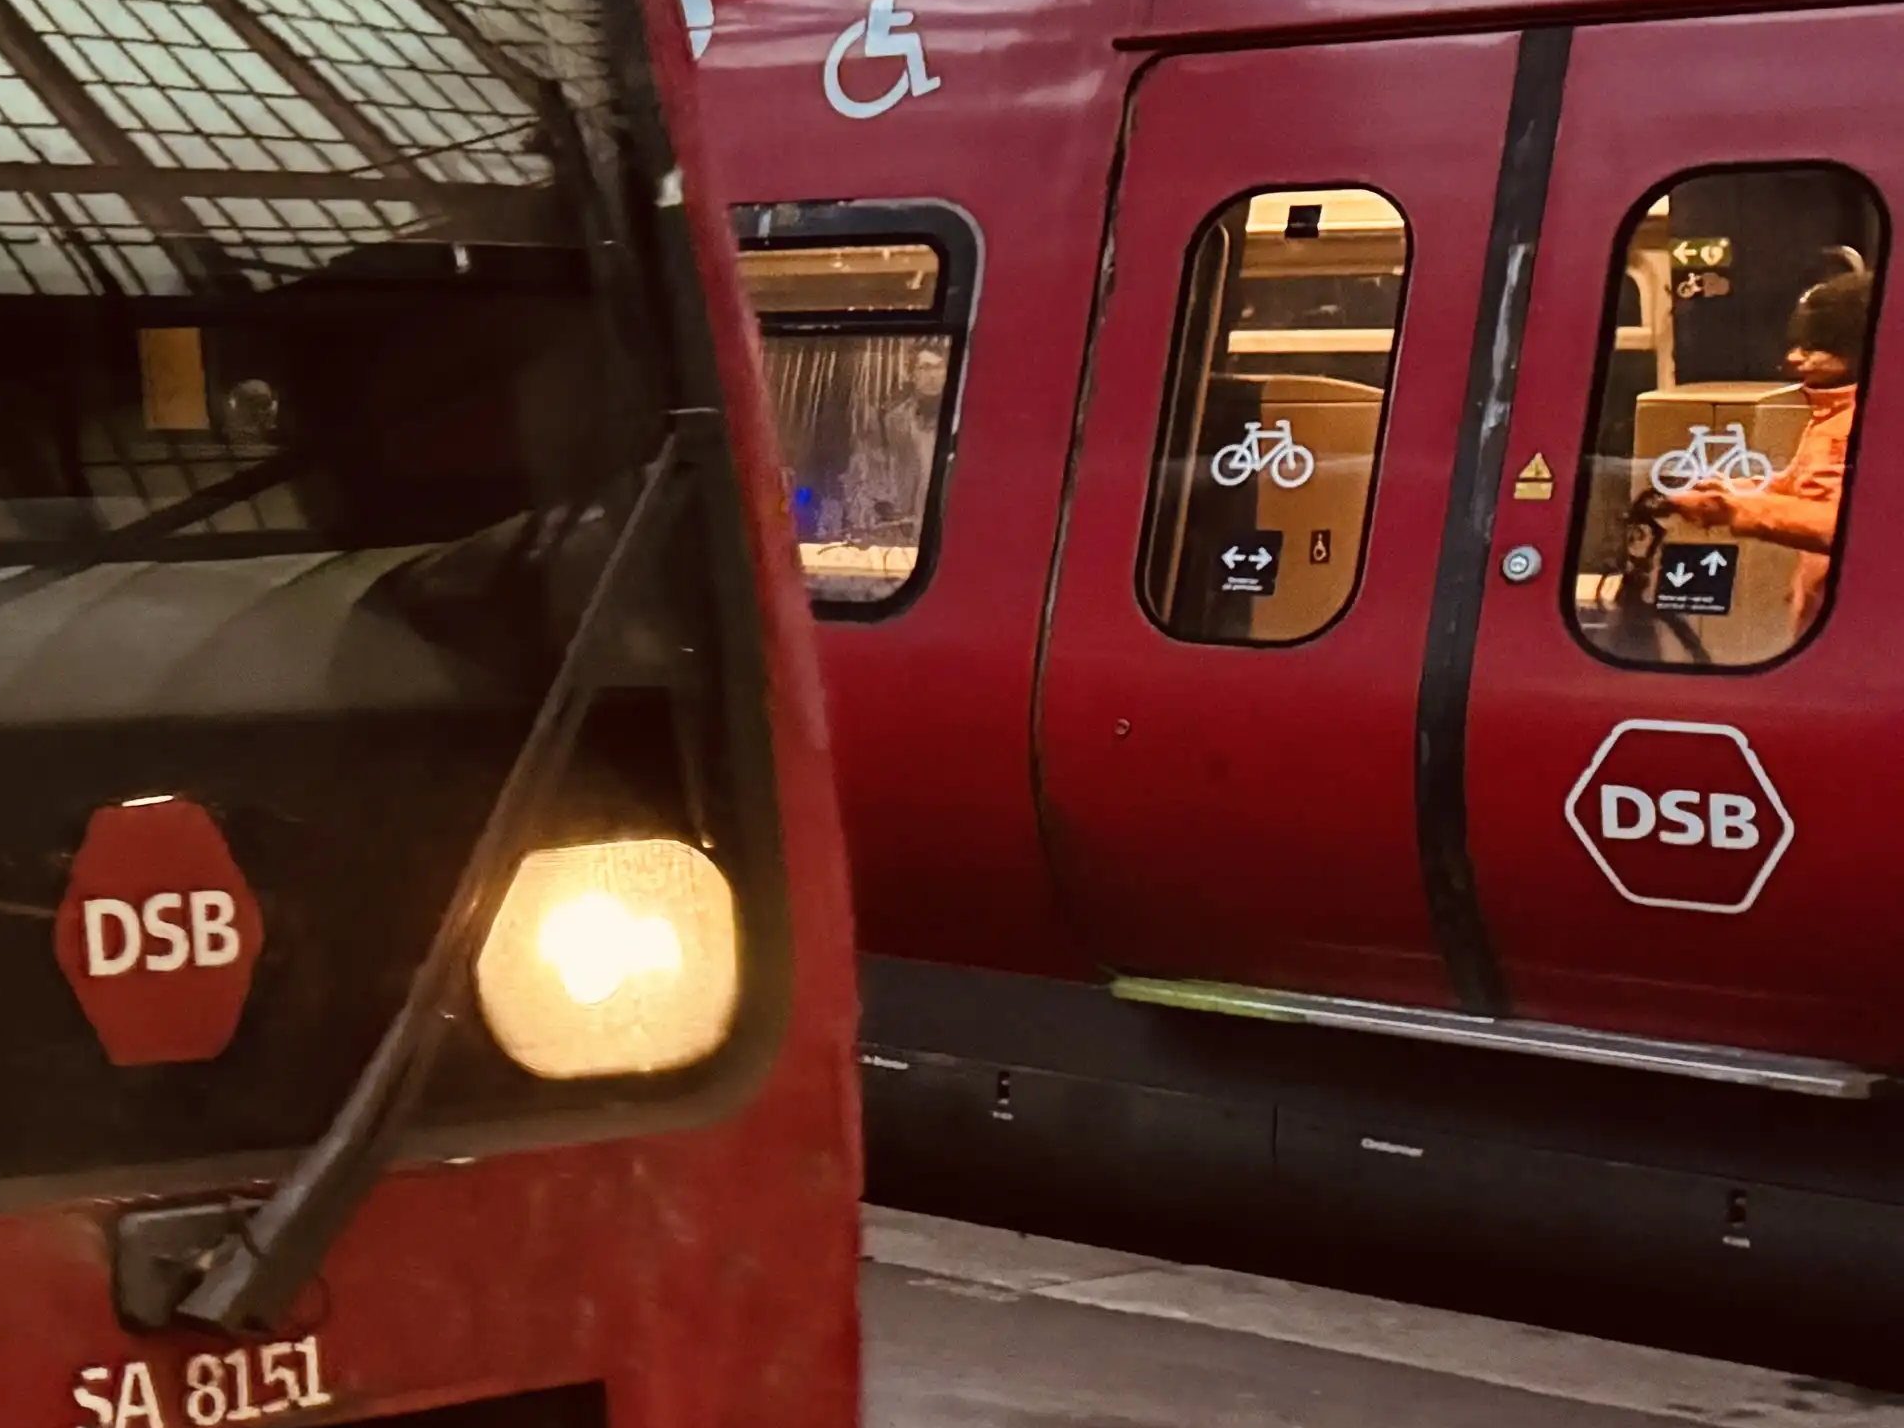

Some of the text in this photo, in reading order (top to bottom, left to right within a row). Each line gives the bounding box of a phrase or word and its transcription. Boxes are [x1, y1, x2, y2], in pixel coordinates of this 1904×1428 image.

[1599, 785, 1762, 853] DSB
[83, 887, 241, 978] DSB
[185, 1335, 333, 1428] 8151
